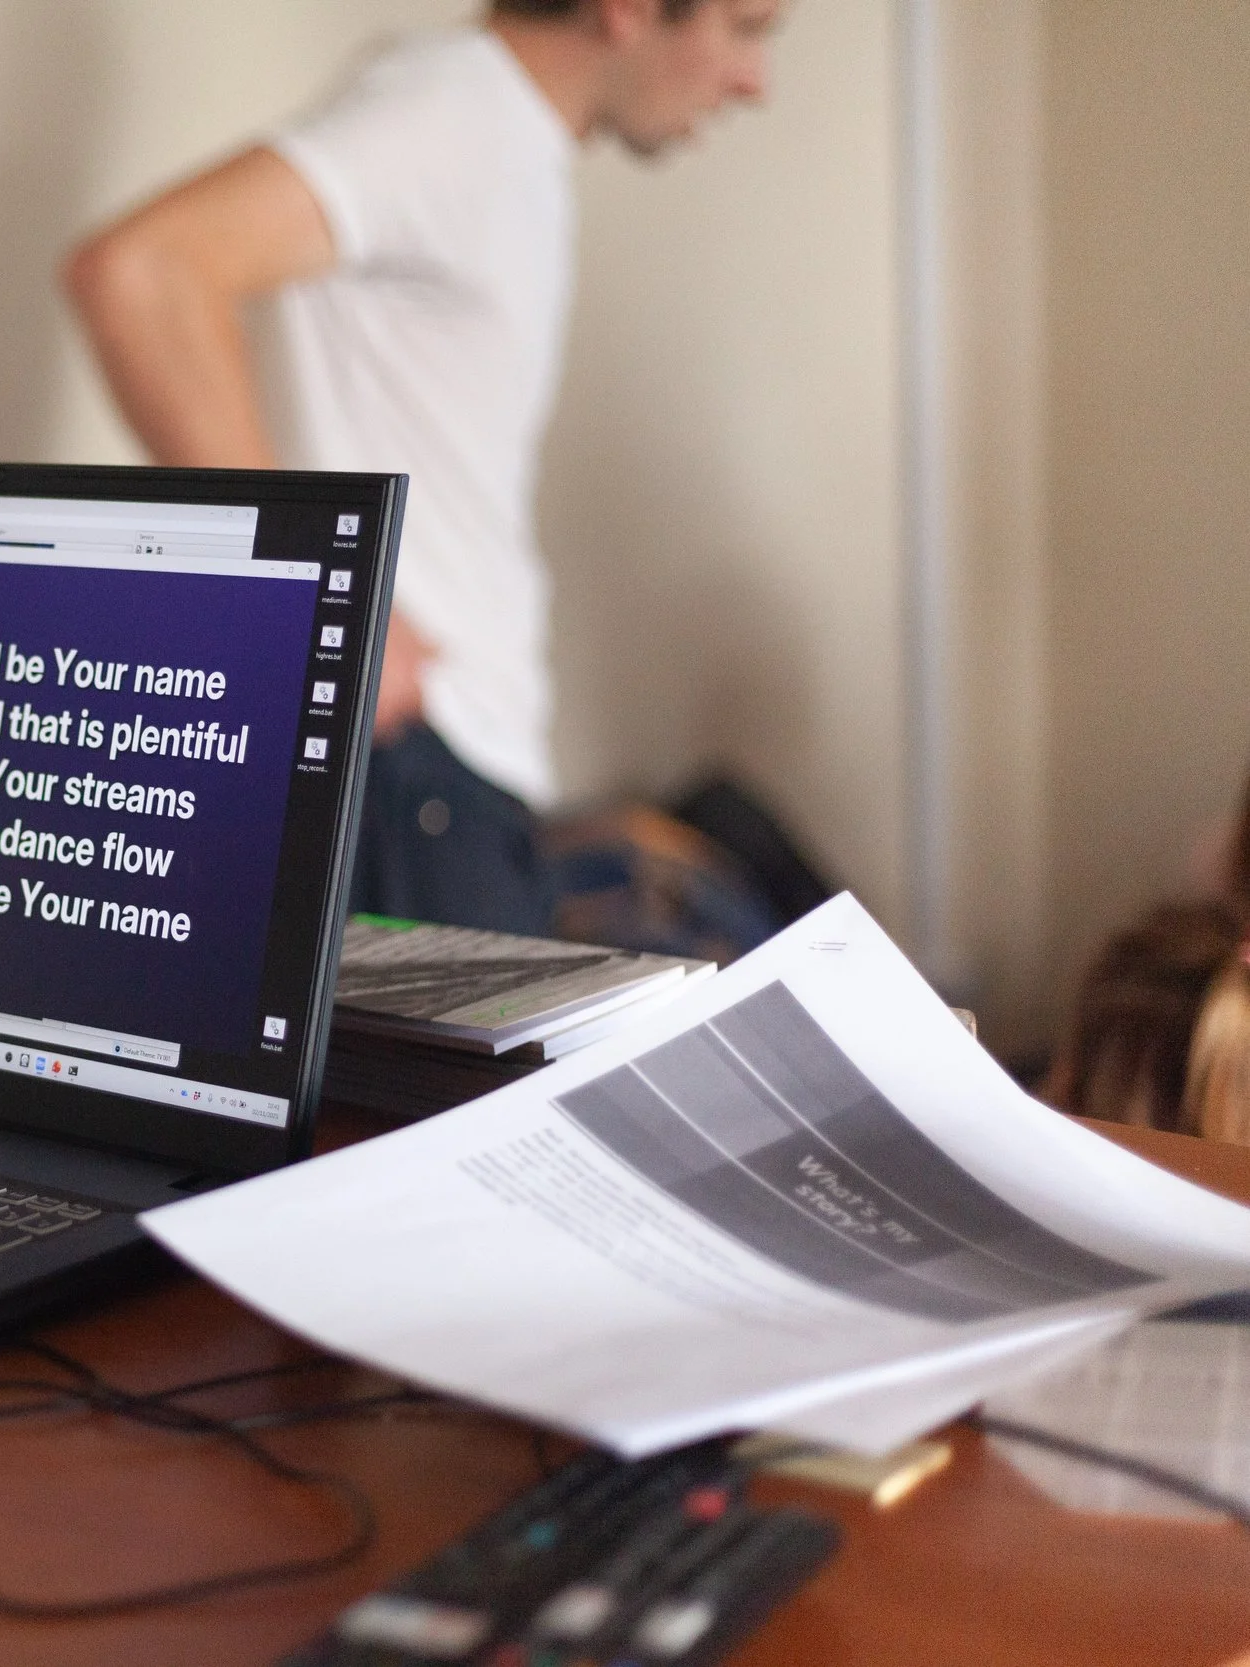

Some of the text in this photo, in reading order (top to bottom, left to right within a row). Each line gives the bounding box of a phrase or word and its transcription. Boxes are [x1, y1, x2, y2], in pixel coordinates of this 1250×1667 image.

[332, 540, 357, 549] lowres.bat
[5, 643, 45, 684] be
[53, 647, 129, 691] Your
[133, 664, 226, 701] name
[315, 651, 342, 661] highres.bat
[8, 702, 73, 745] that
[76, 708, 105, 749] is
[108, 714, 249, 764] plentiful
[308, 707, 333, 716] extend.bat
[63, 772, 196, 821] streams
[102, 831, 175, 879] flow
[20, 878, 95, 927] Your
[98, 901, 191, 942] name
[123, 1046, 140, 1056] Default
[260, 1041, 283, 1052] finish.bat
[794, 1183, 878, 1236] story?
[798, 1154, 880, 1219] What's
